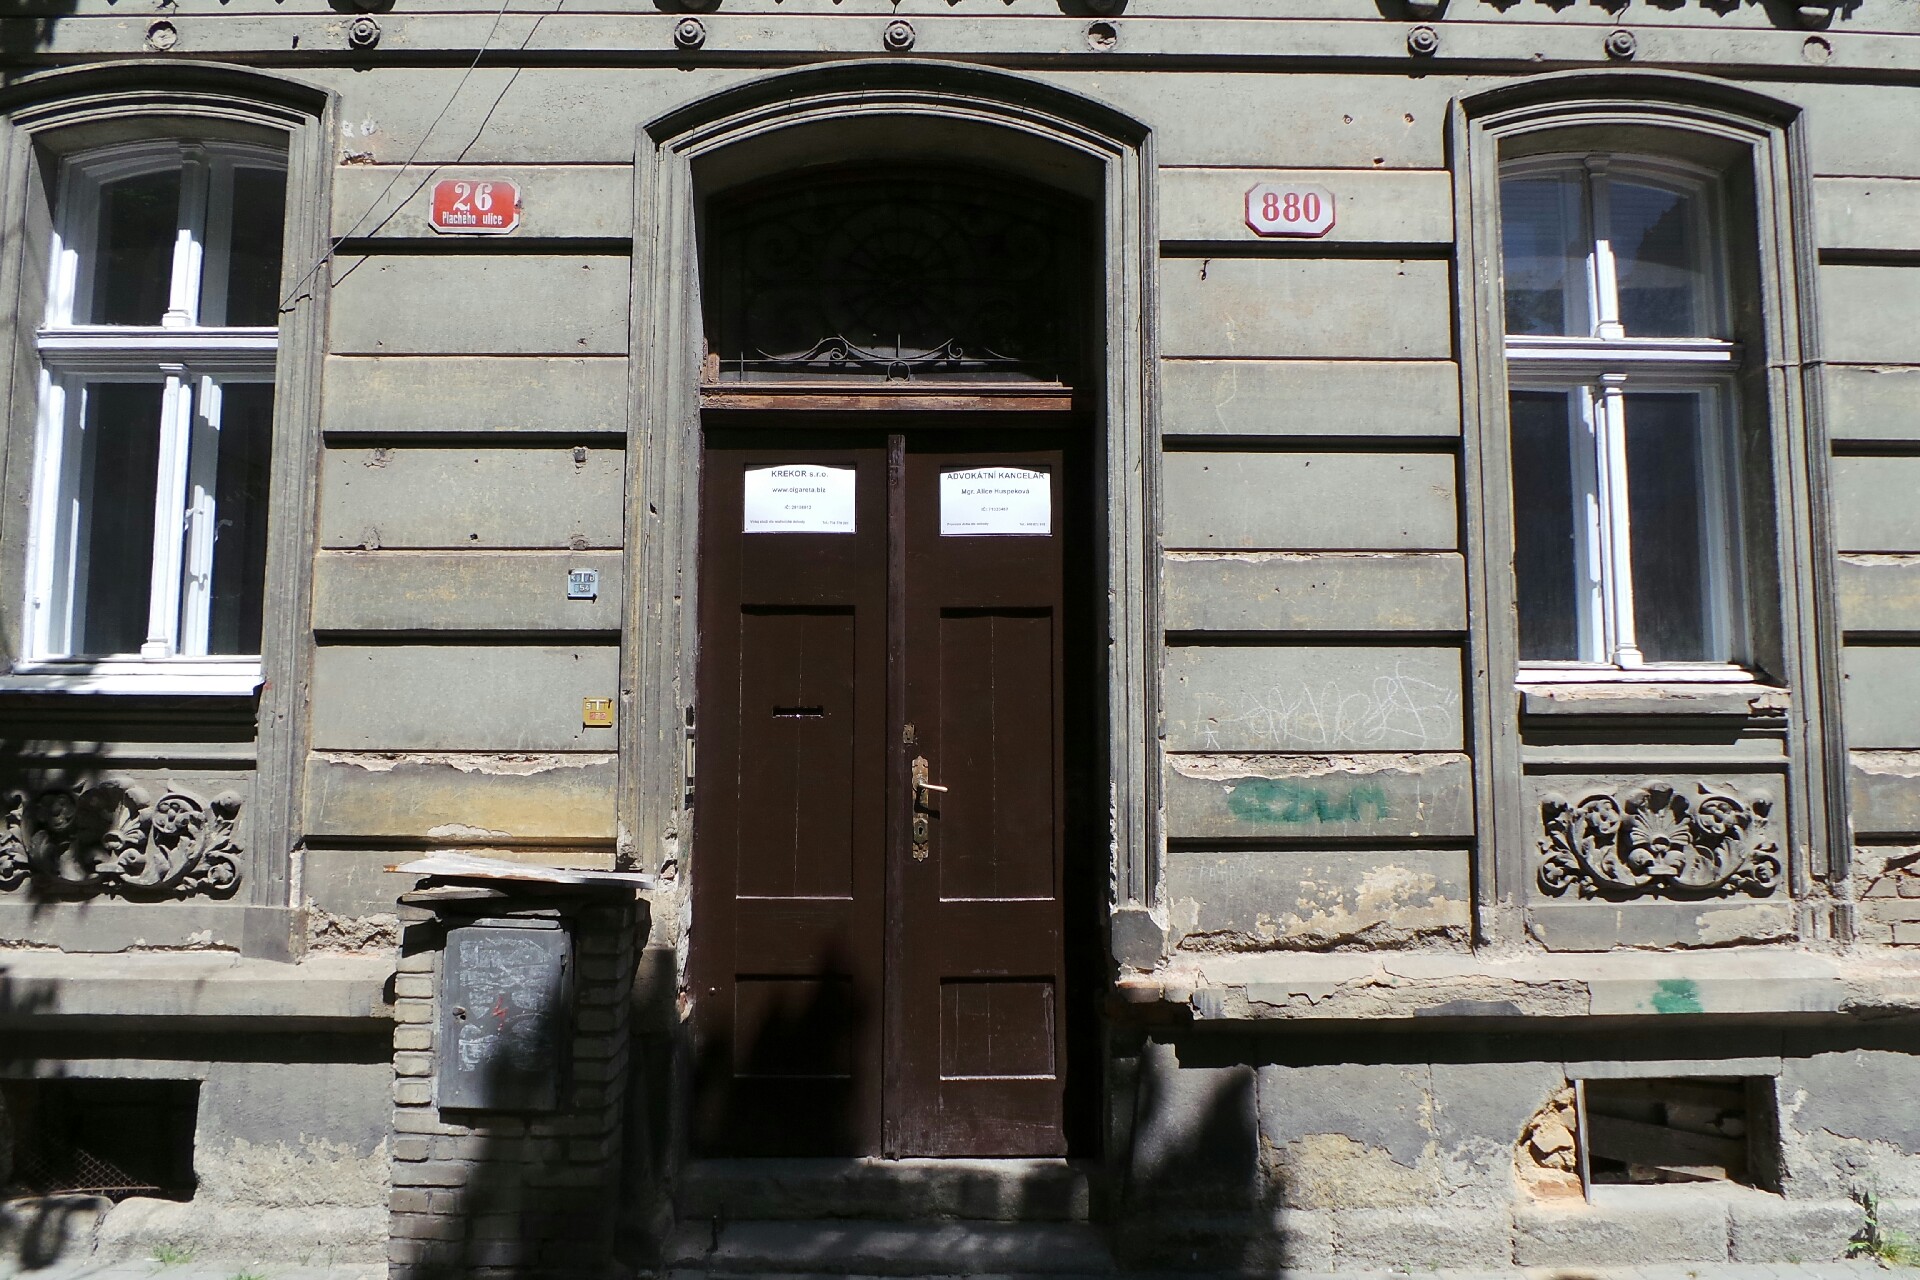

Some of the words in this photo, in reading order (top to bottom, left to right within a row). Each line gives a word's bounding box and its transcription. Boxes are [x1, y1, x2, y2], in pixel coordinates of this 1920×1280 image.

[453, 182, 493, 211] 26
[1262, 192, 1321, 222] 880
[442, 211, 476, 225] Plachého
[482, 212, 503, 225] ulice
[771, 470, 807, 478] KREKOR
